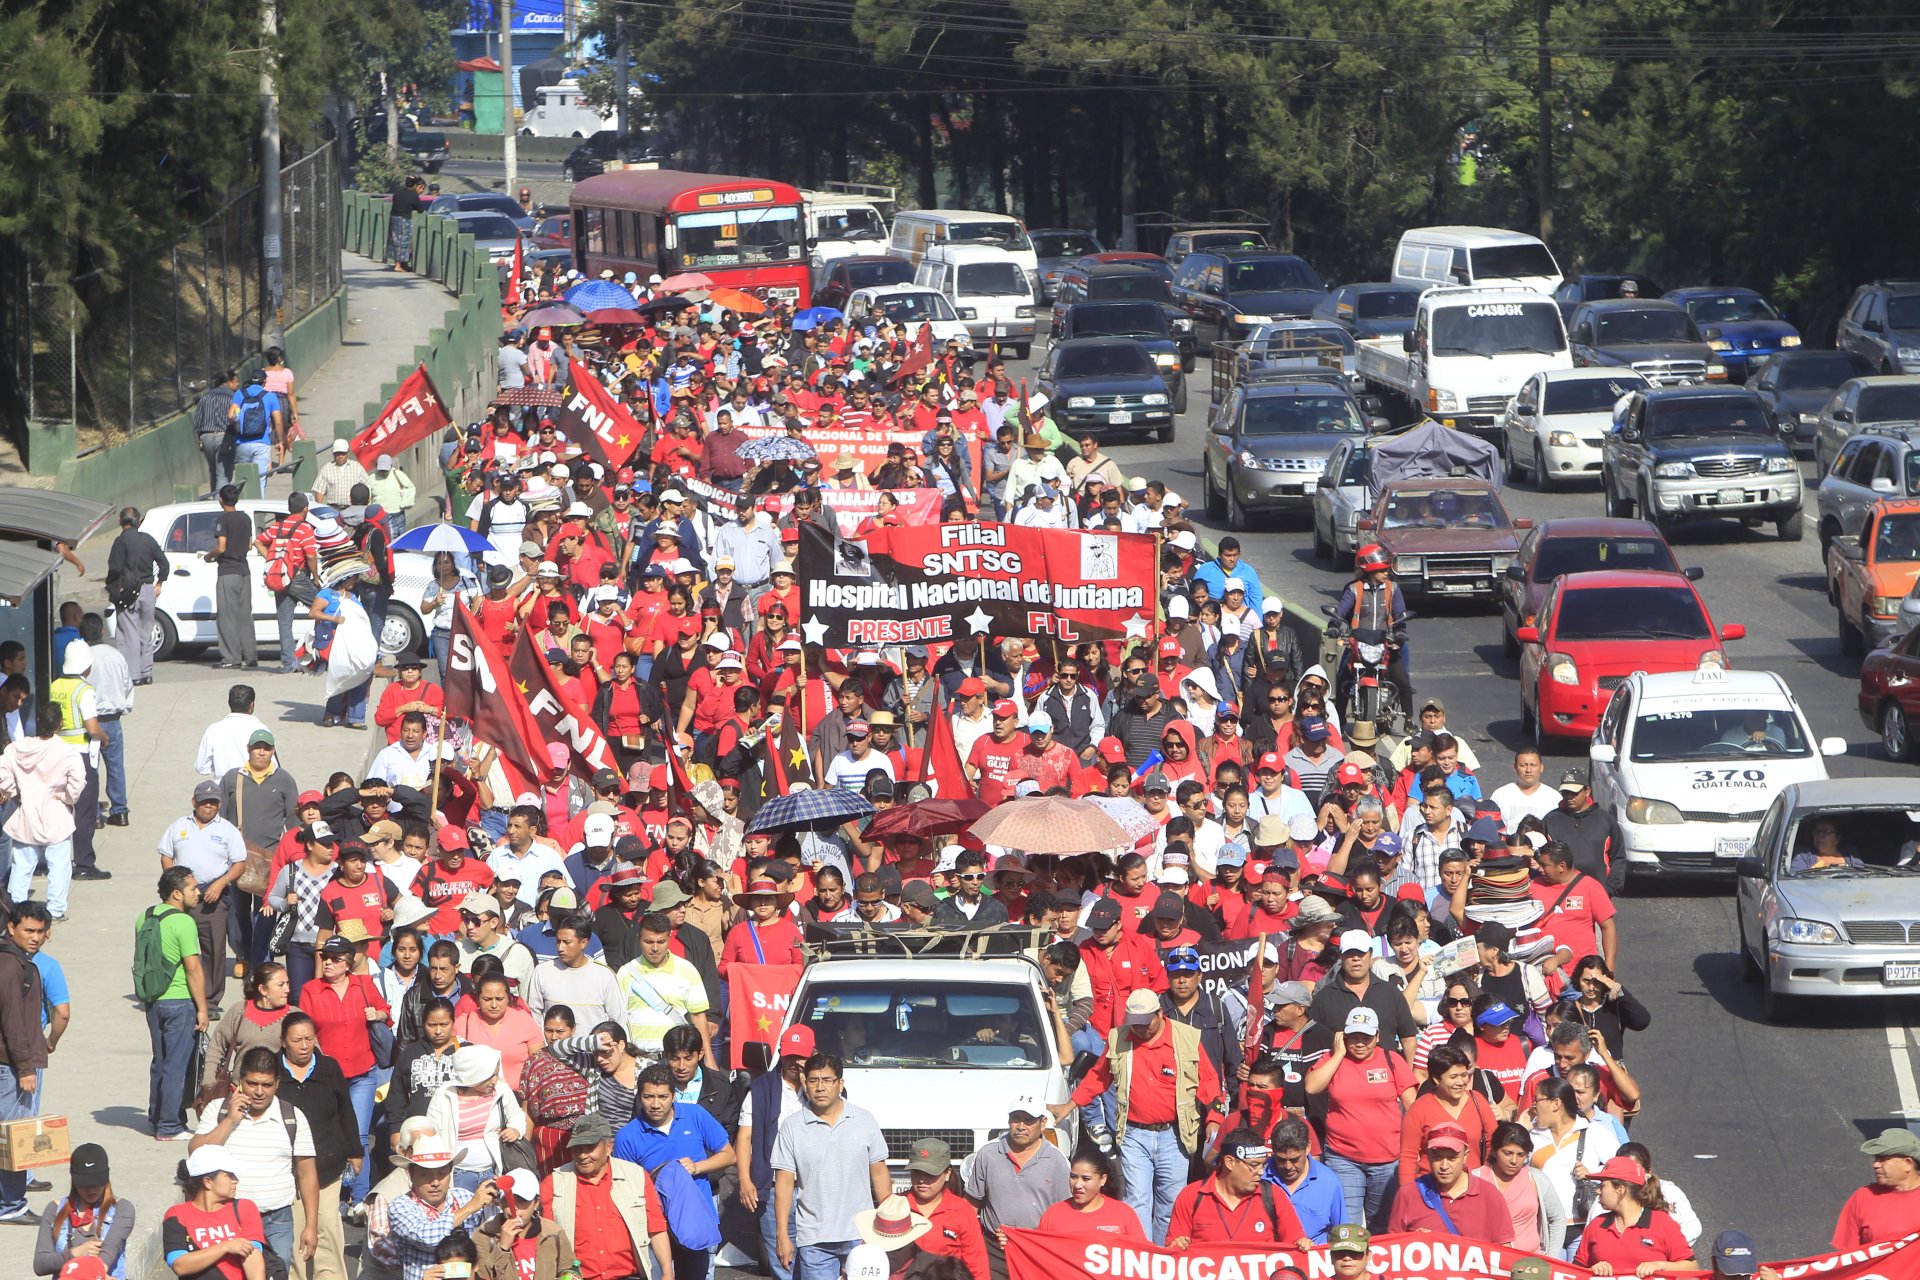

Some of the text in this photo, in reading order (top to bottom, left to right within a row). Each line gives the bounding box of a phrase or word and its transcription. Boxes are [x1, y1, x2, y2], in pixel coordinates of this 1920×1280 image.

[1468, 304, 1523, 317] C443BGK
[567, 391, 615, 444] FNL
[867, 431, 882, 441] DE
[841, 445, 856, 454] DE
[941, 524, 1005, 548] Filial
[922, 549, 1023, 577] SNTSG
[809, 577, 1143, 611] Hospital Nacional de Jutiapa
[848, 615, 953, 643] PRESENTE
[1700, 672, 1723, 680] TAXI
[1694, 769, 1765, 782] 370
[1692, 781, 1768, 790] GUATEMALA
[430, 881, 474, 893] LONG BEACH
[195, 1224, 236, 1242] FNL
[862, 1267, 880, 1278] GAP
